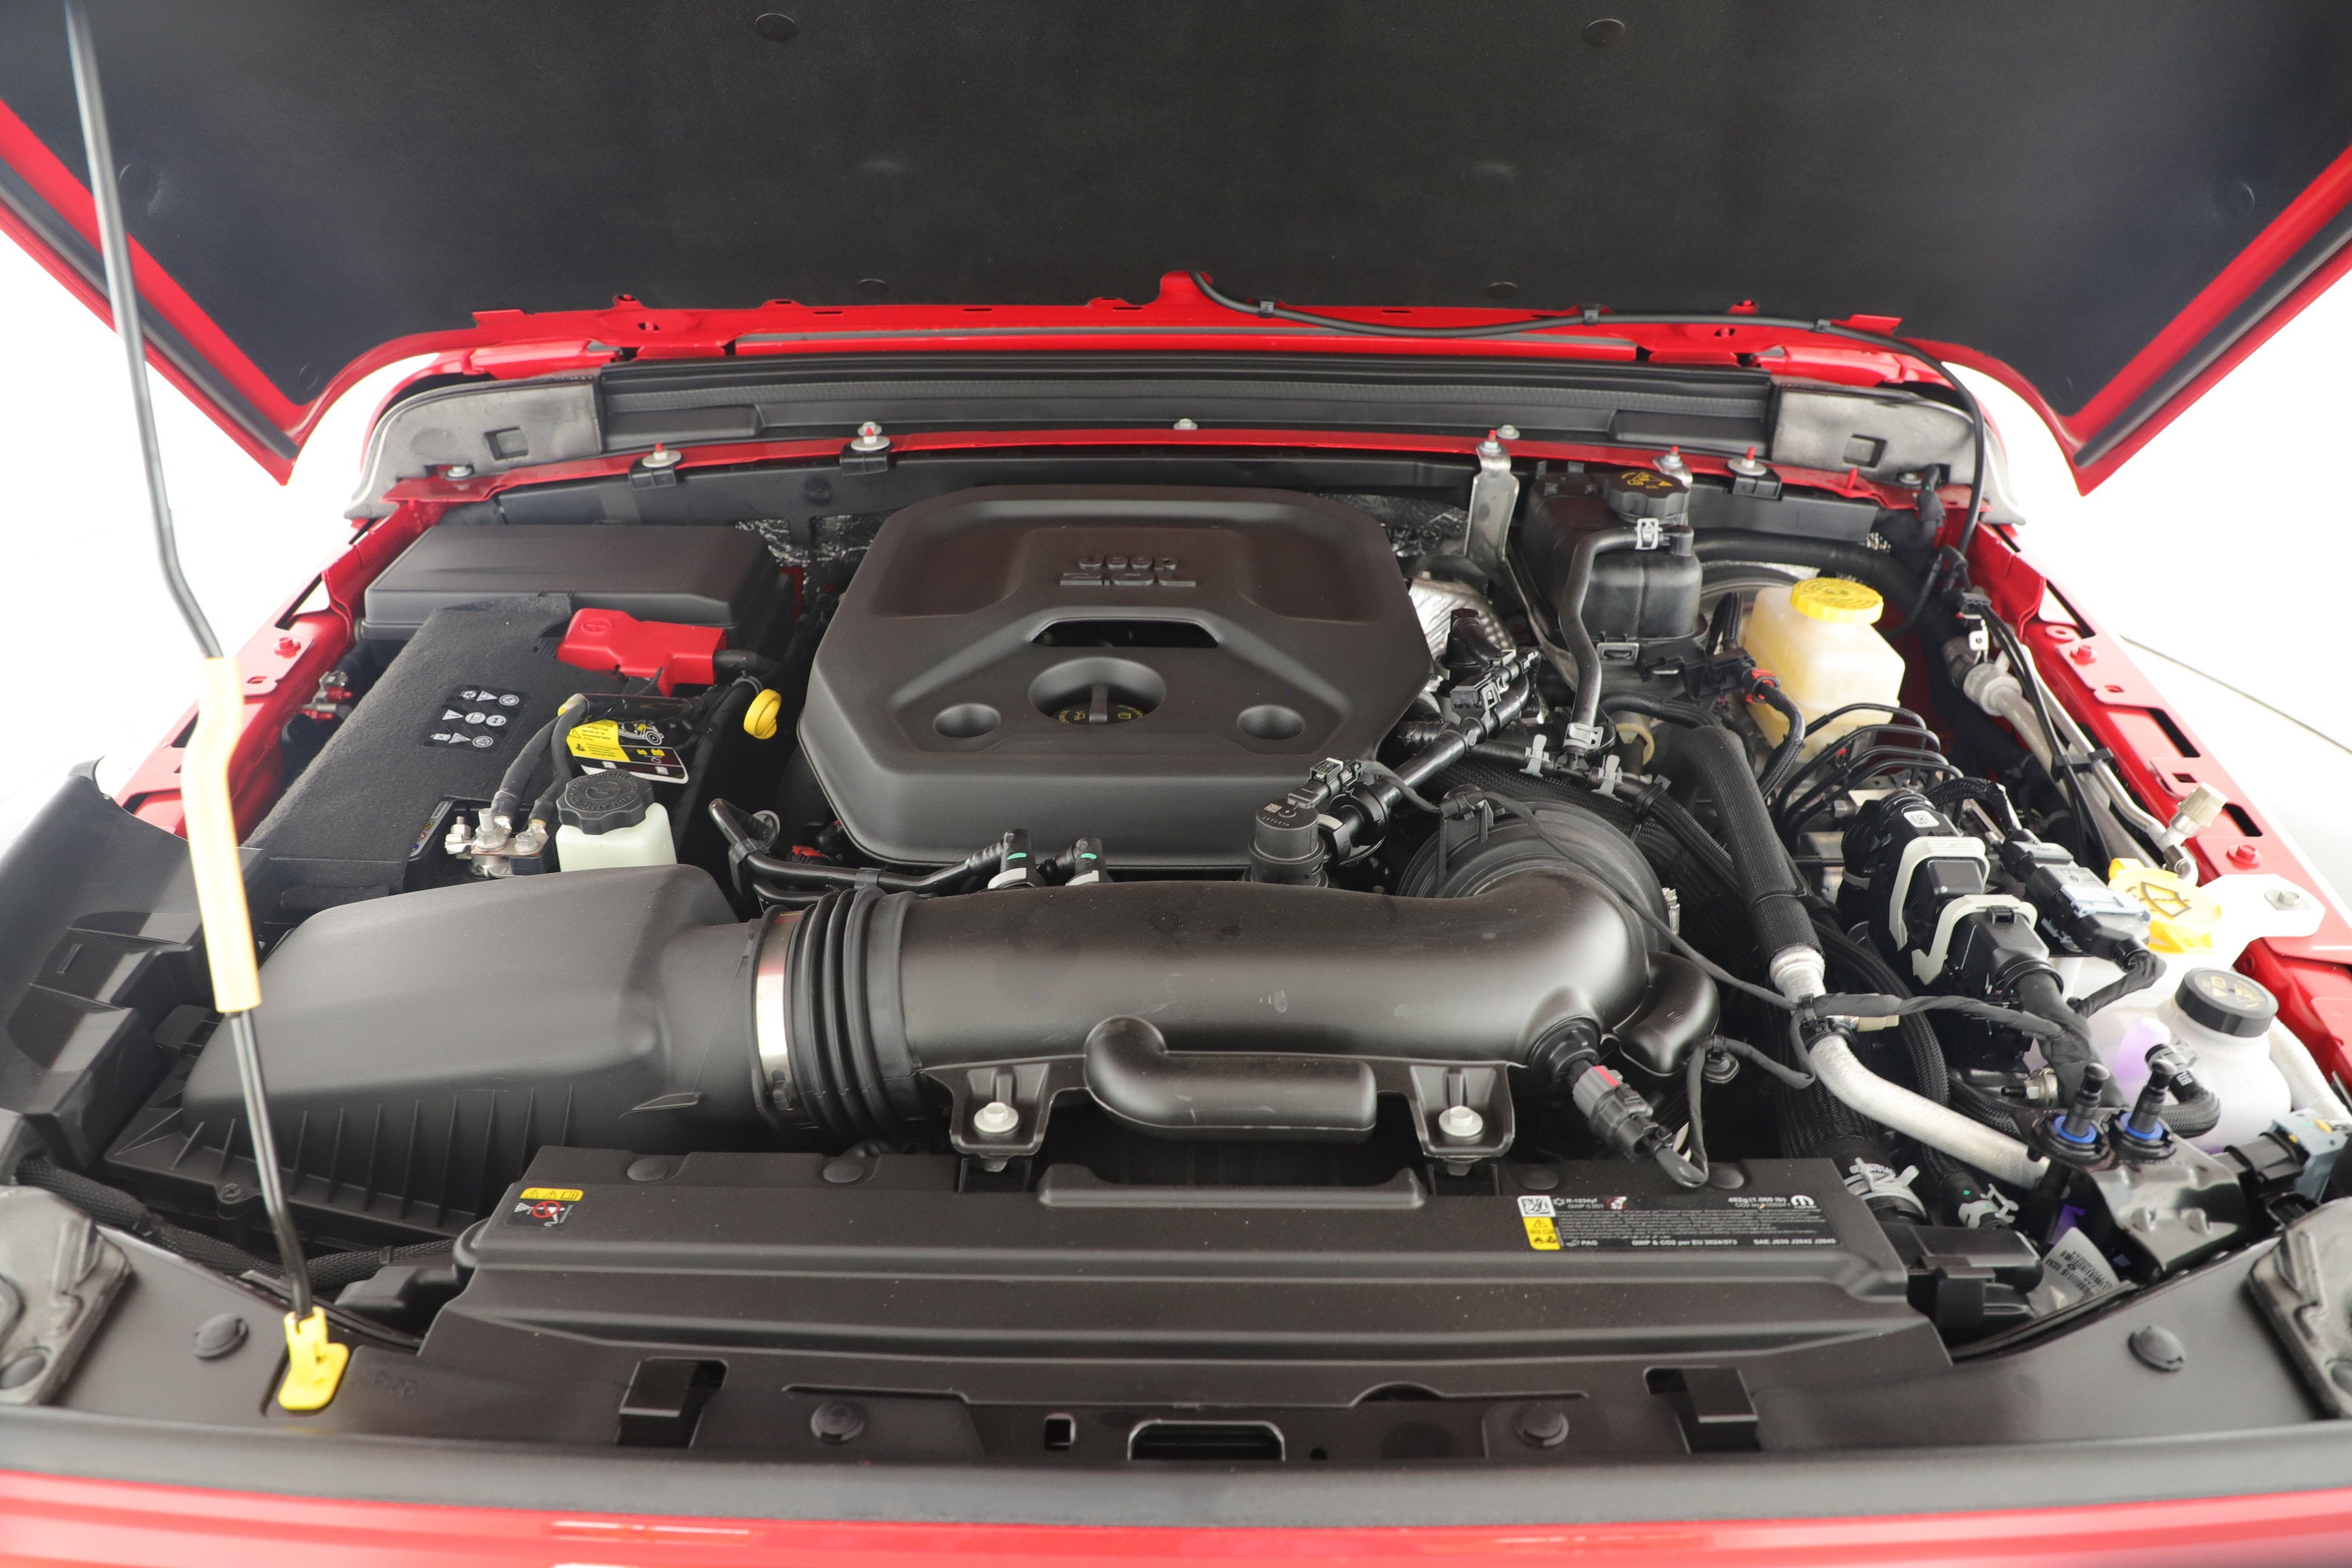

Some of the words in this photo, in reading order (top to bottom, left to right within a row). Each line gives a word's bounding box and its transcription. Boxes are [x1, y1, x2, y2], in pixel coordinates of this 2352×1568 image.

[1078, 553, 1179, 572] Jeep
[1059, 572, 1196, 587] 2.0L
[570, 797, 607, 810] APPROVED
